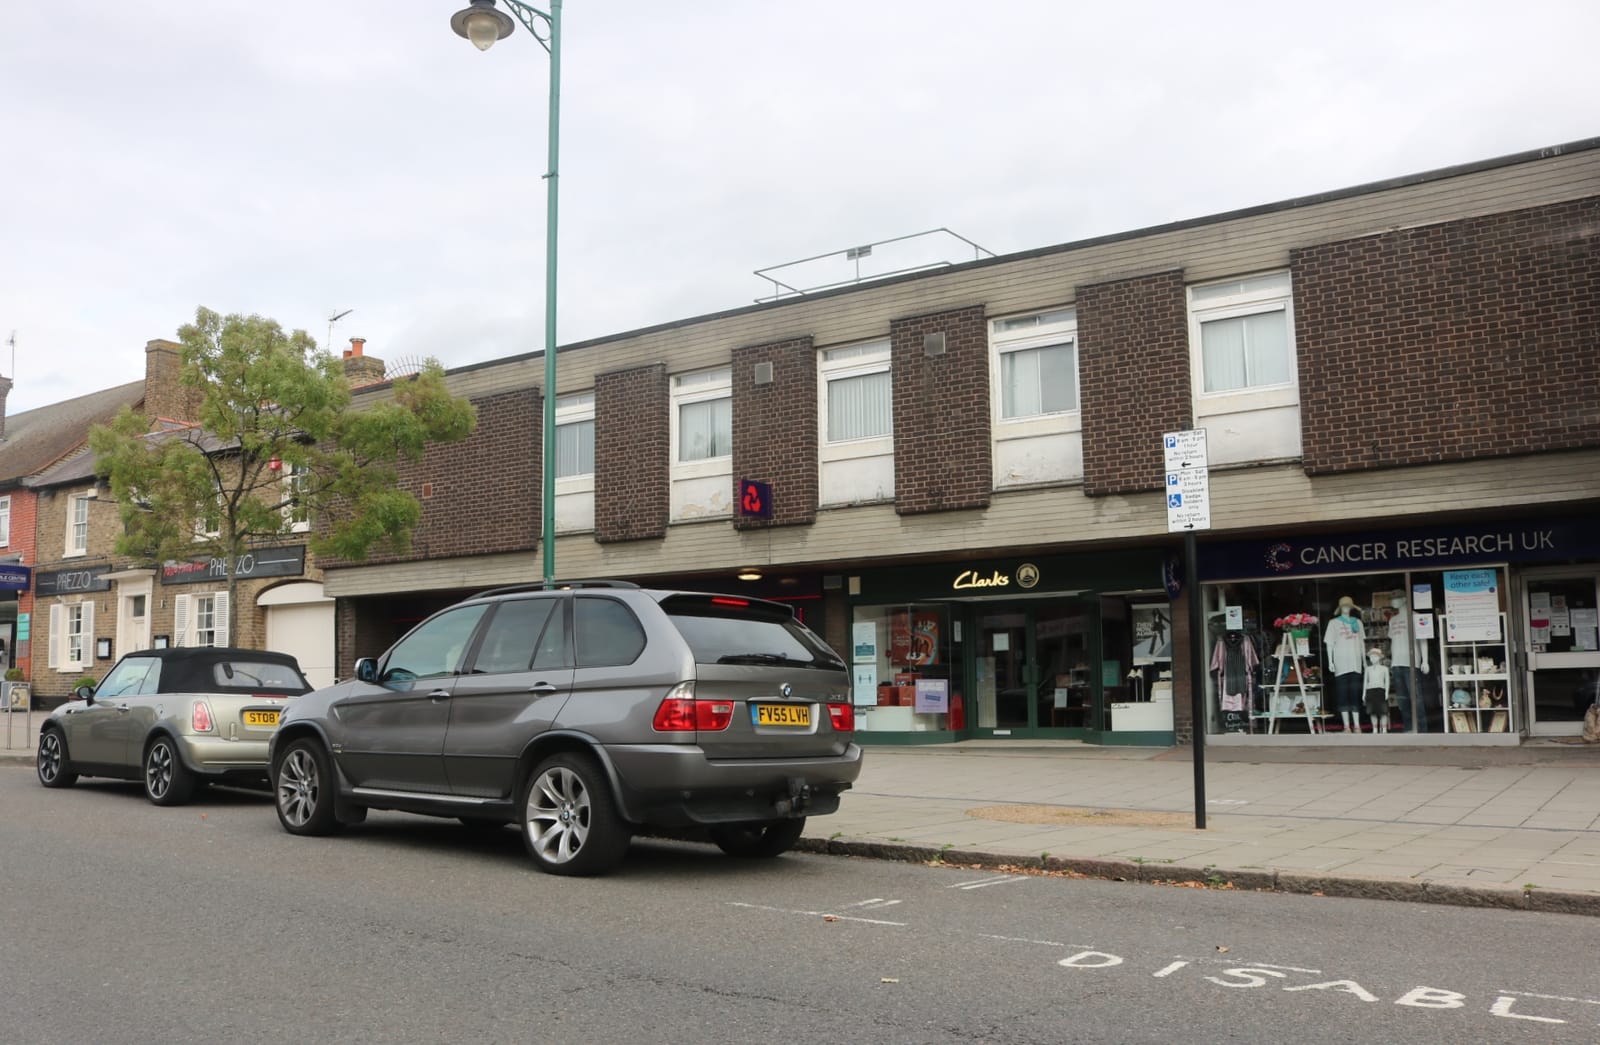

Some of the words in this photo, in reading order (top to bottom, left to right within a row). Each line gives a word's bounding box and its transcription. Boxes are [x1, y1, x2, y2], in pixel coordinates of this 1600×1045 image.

[1300, 542, 1387, 565] CANCER
[1396, 532, 1513, 558] RESEARCH
[1521, 529, 1554, 550] UK
[209, 553, 254, 576] PREZO
[56, 570, 91, 591] PREZZO
[953, 570, 1009, 589] Clarks
[249, 712, 275, 723] ST08
[759, 706, 787, 722] FV55
[789, 706, 808, 723] LVH
